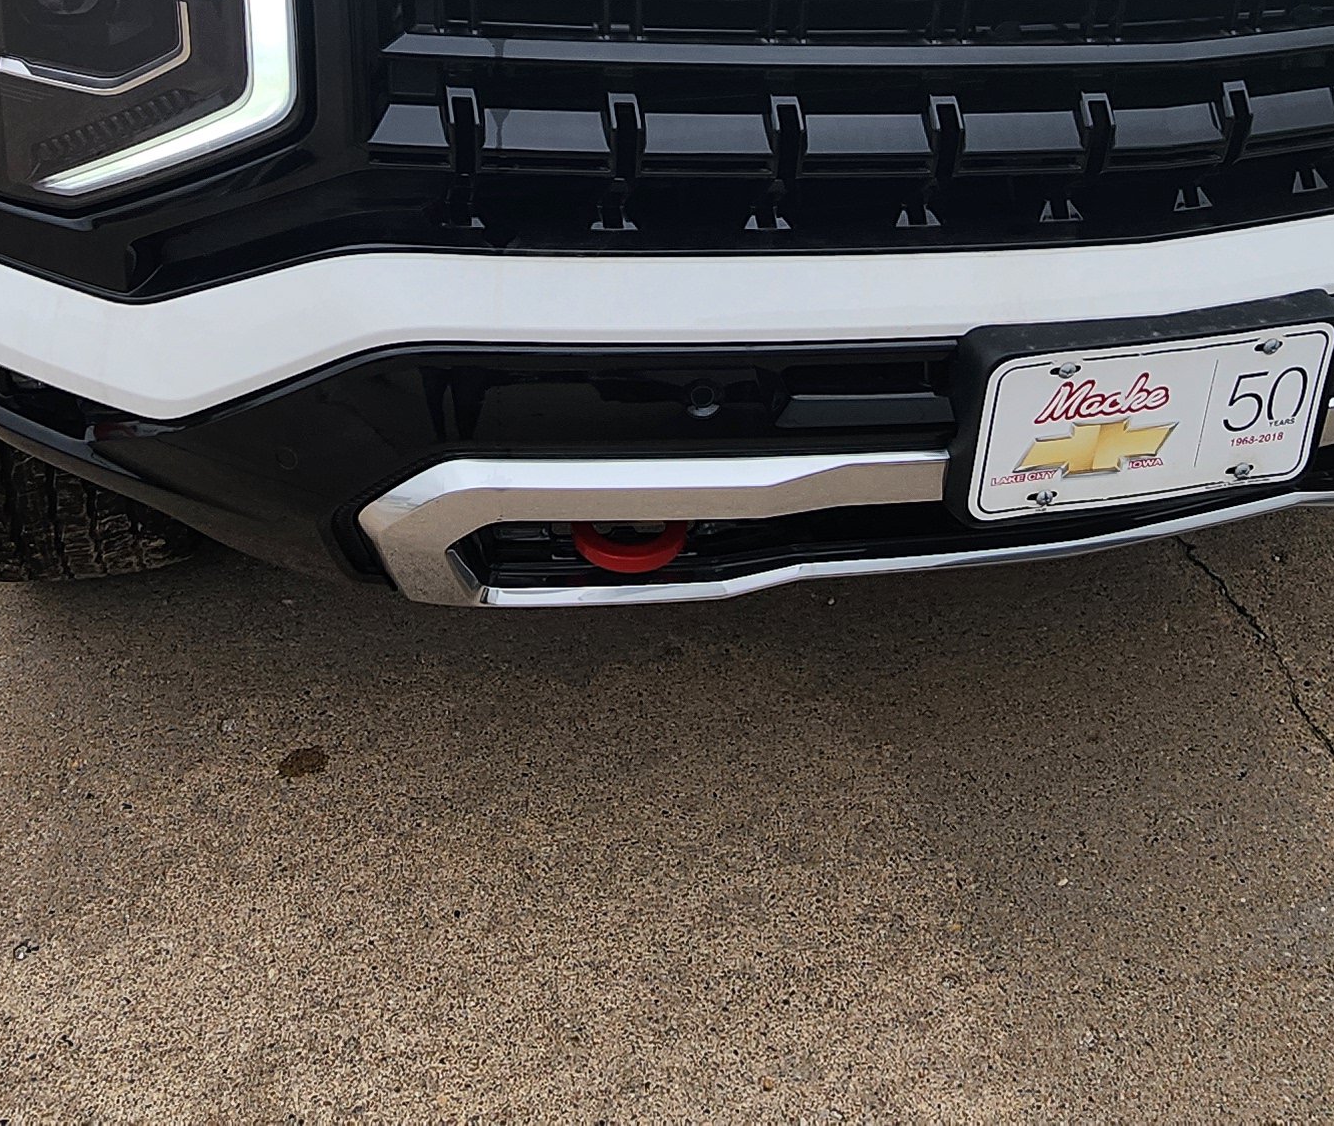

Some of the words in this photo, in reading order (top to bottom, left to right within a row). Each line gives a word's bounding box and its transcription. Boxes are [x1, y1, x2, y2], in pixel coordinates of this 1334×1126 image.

[1033, 372, 1169, 424] Macke
[1223, 366, 1308, 432] 50
[1269, 417, 1295, 427] YEARS
[1127, 457, 1164, 470] IOWA
[990, 473, 1025, 487] LAKE
[1025, 469, 1057, 482] CITY
